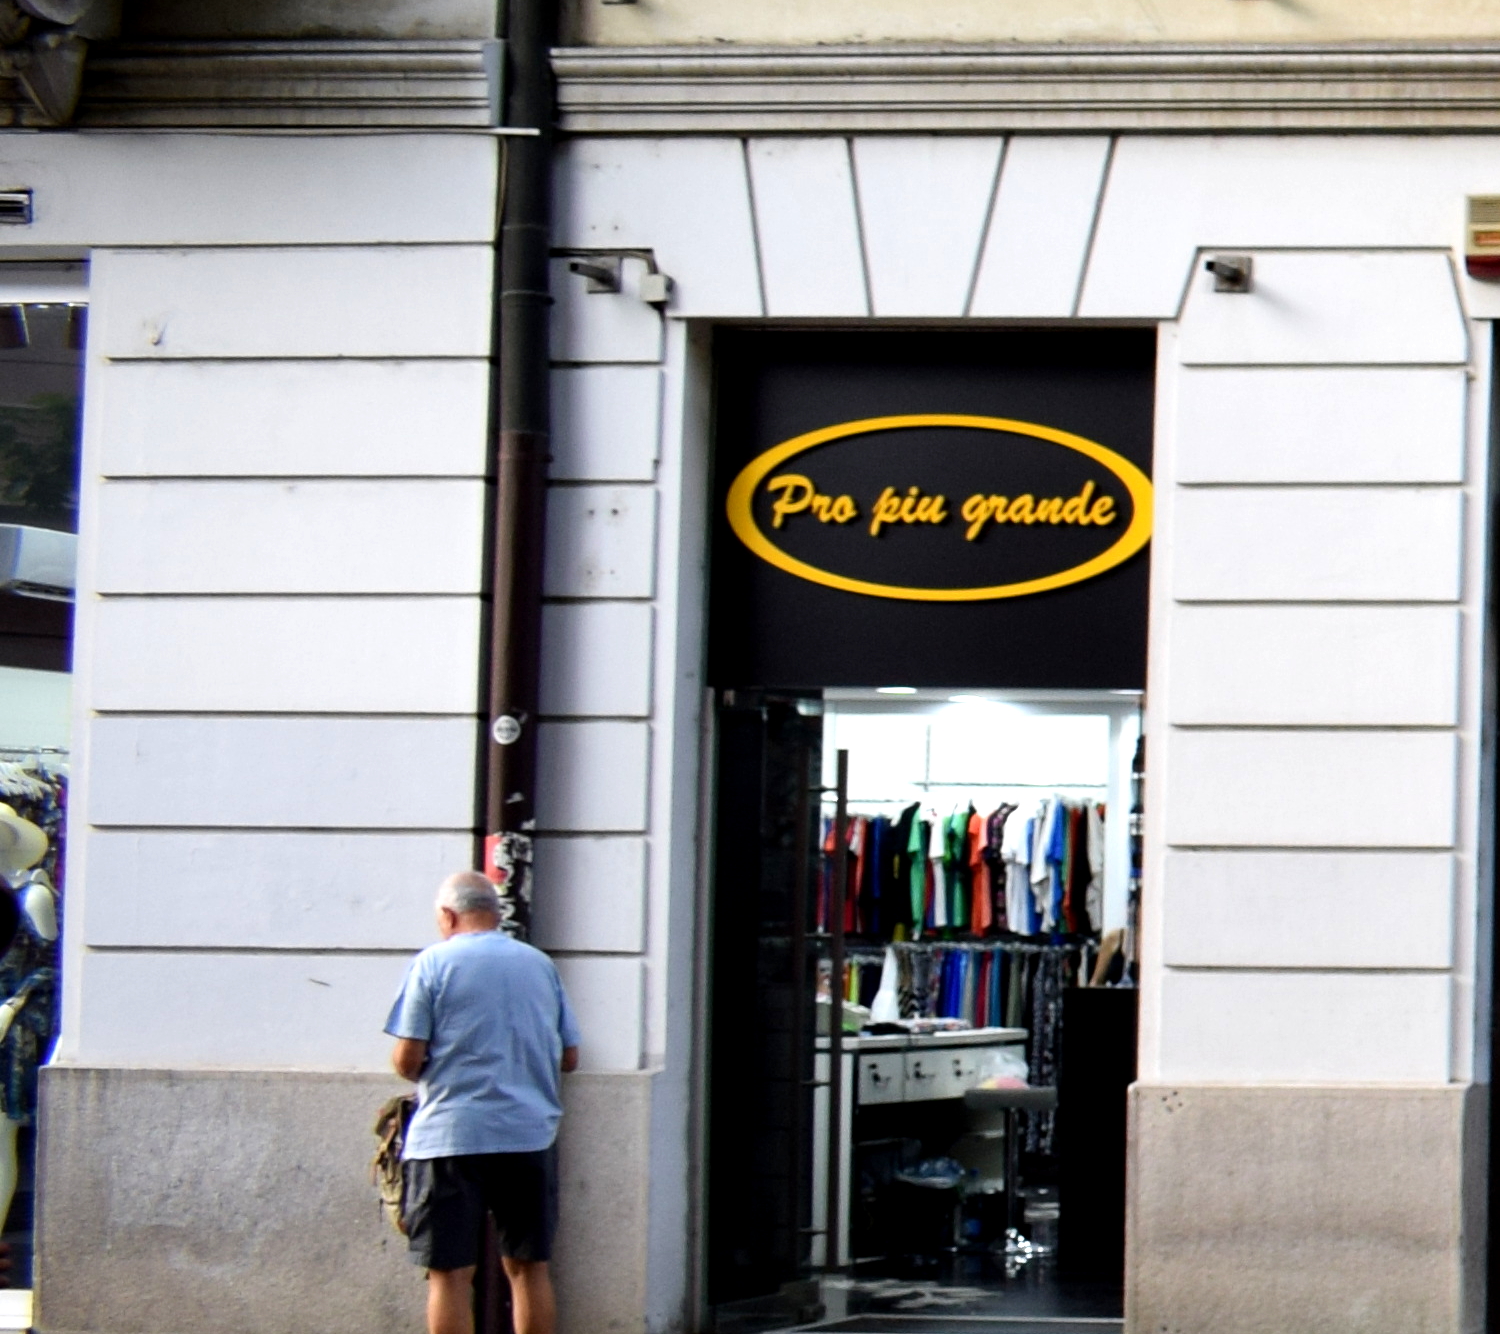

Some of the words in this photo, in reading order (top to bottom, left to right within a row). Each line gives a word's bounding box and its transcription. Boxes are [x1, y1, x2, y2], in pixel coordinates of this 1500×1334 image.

[766, 474, 857, 529] Pro
[870, 483, 948, 537] piu
[961, 480, 1117, 542] grande
